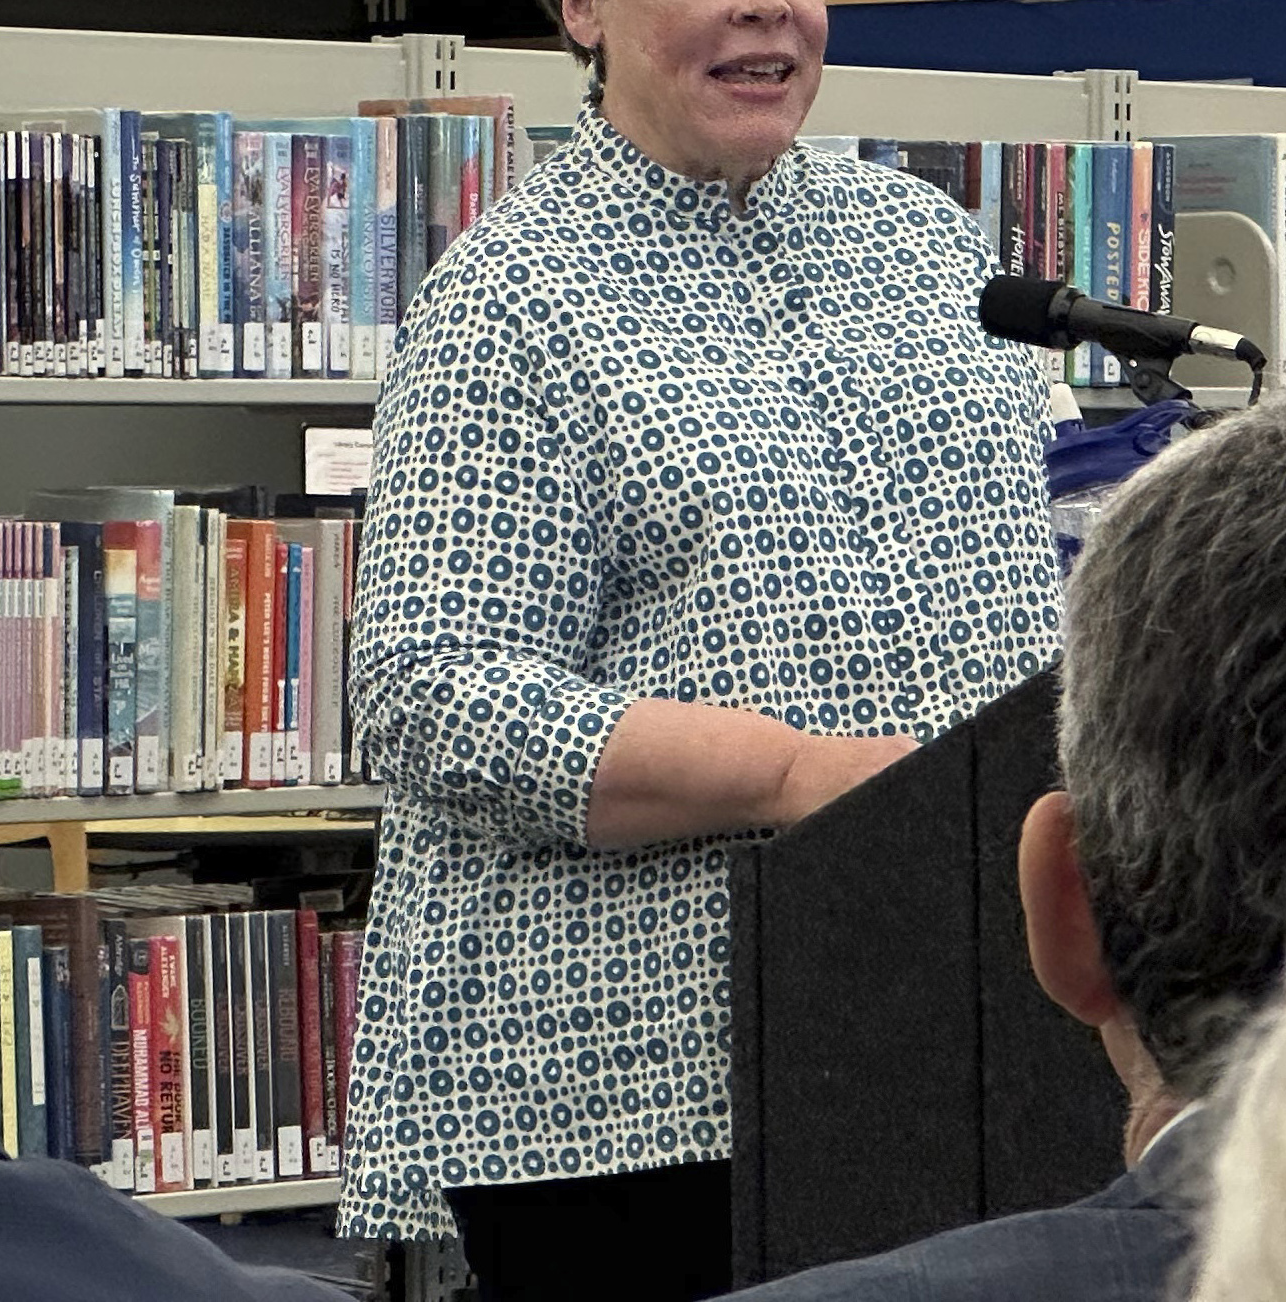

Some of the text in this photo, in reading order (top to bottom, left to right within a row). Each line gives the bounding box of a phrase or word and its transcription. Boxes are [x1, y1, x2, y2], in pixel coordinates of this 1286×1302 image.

[129, 173, 142, 233] Summer
[248, 212, 262, 303] ALLIANA
[380, 214, 396, 324] SILVERWOR
[1106, 221, 1120, 301] POSTED
[1137, 229, 1152, 312] SIDEKIC
[227, 627, 240, 642] &
[161, 946, 169, 999] ALEXANDER
[279, 988, 297, 1063] REBOUND
[133, 1029, 151, 1131] MUHAMMAD ALI
[160, 1050, 173, 1133] NO RETUR
